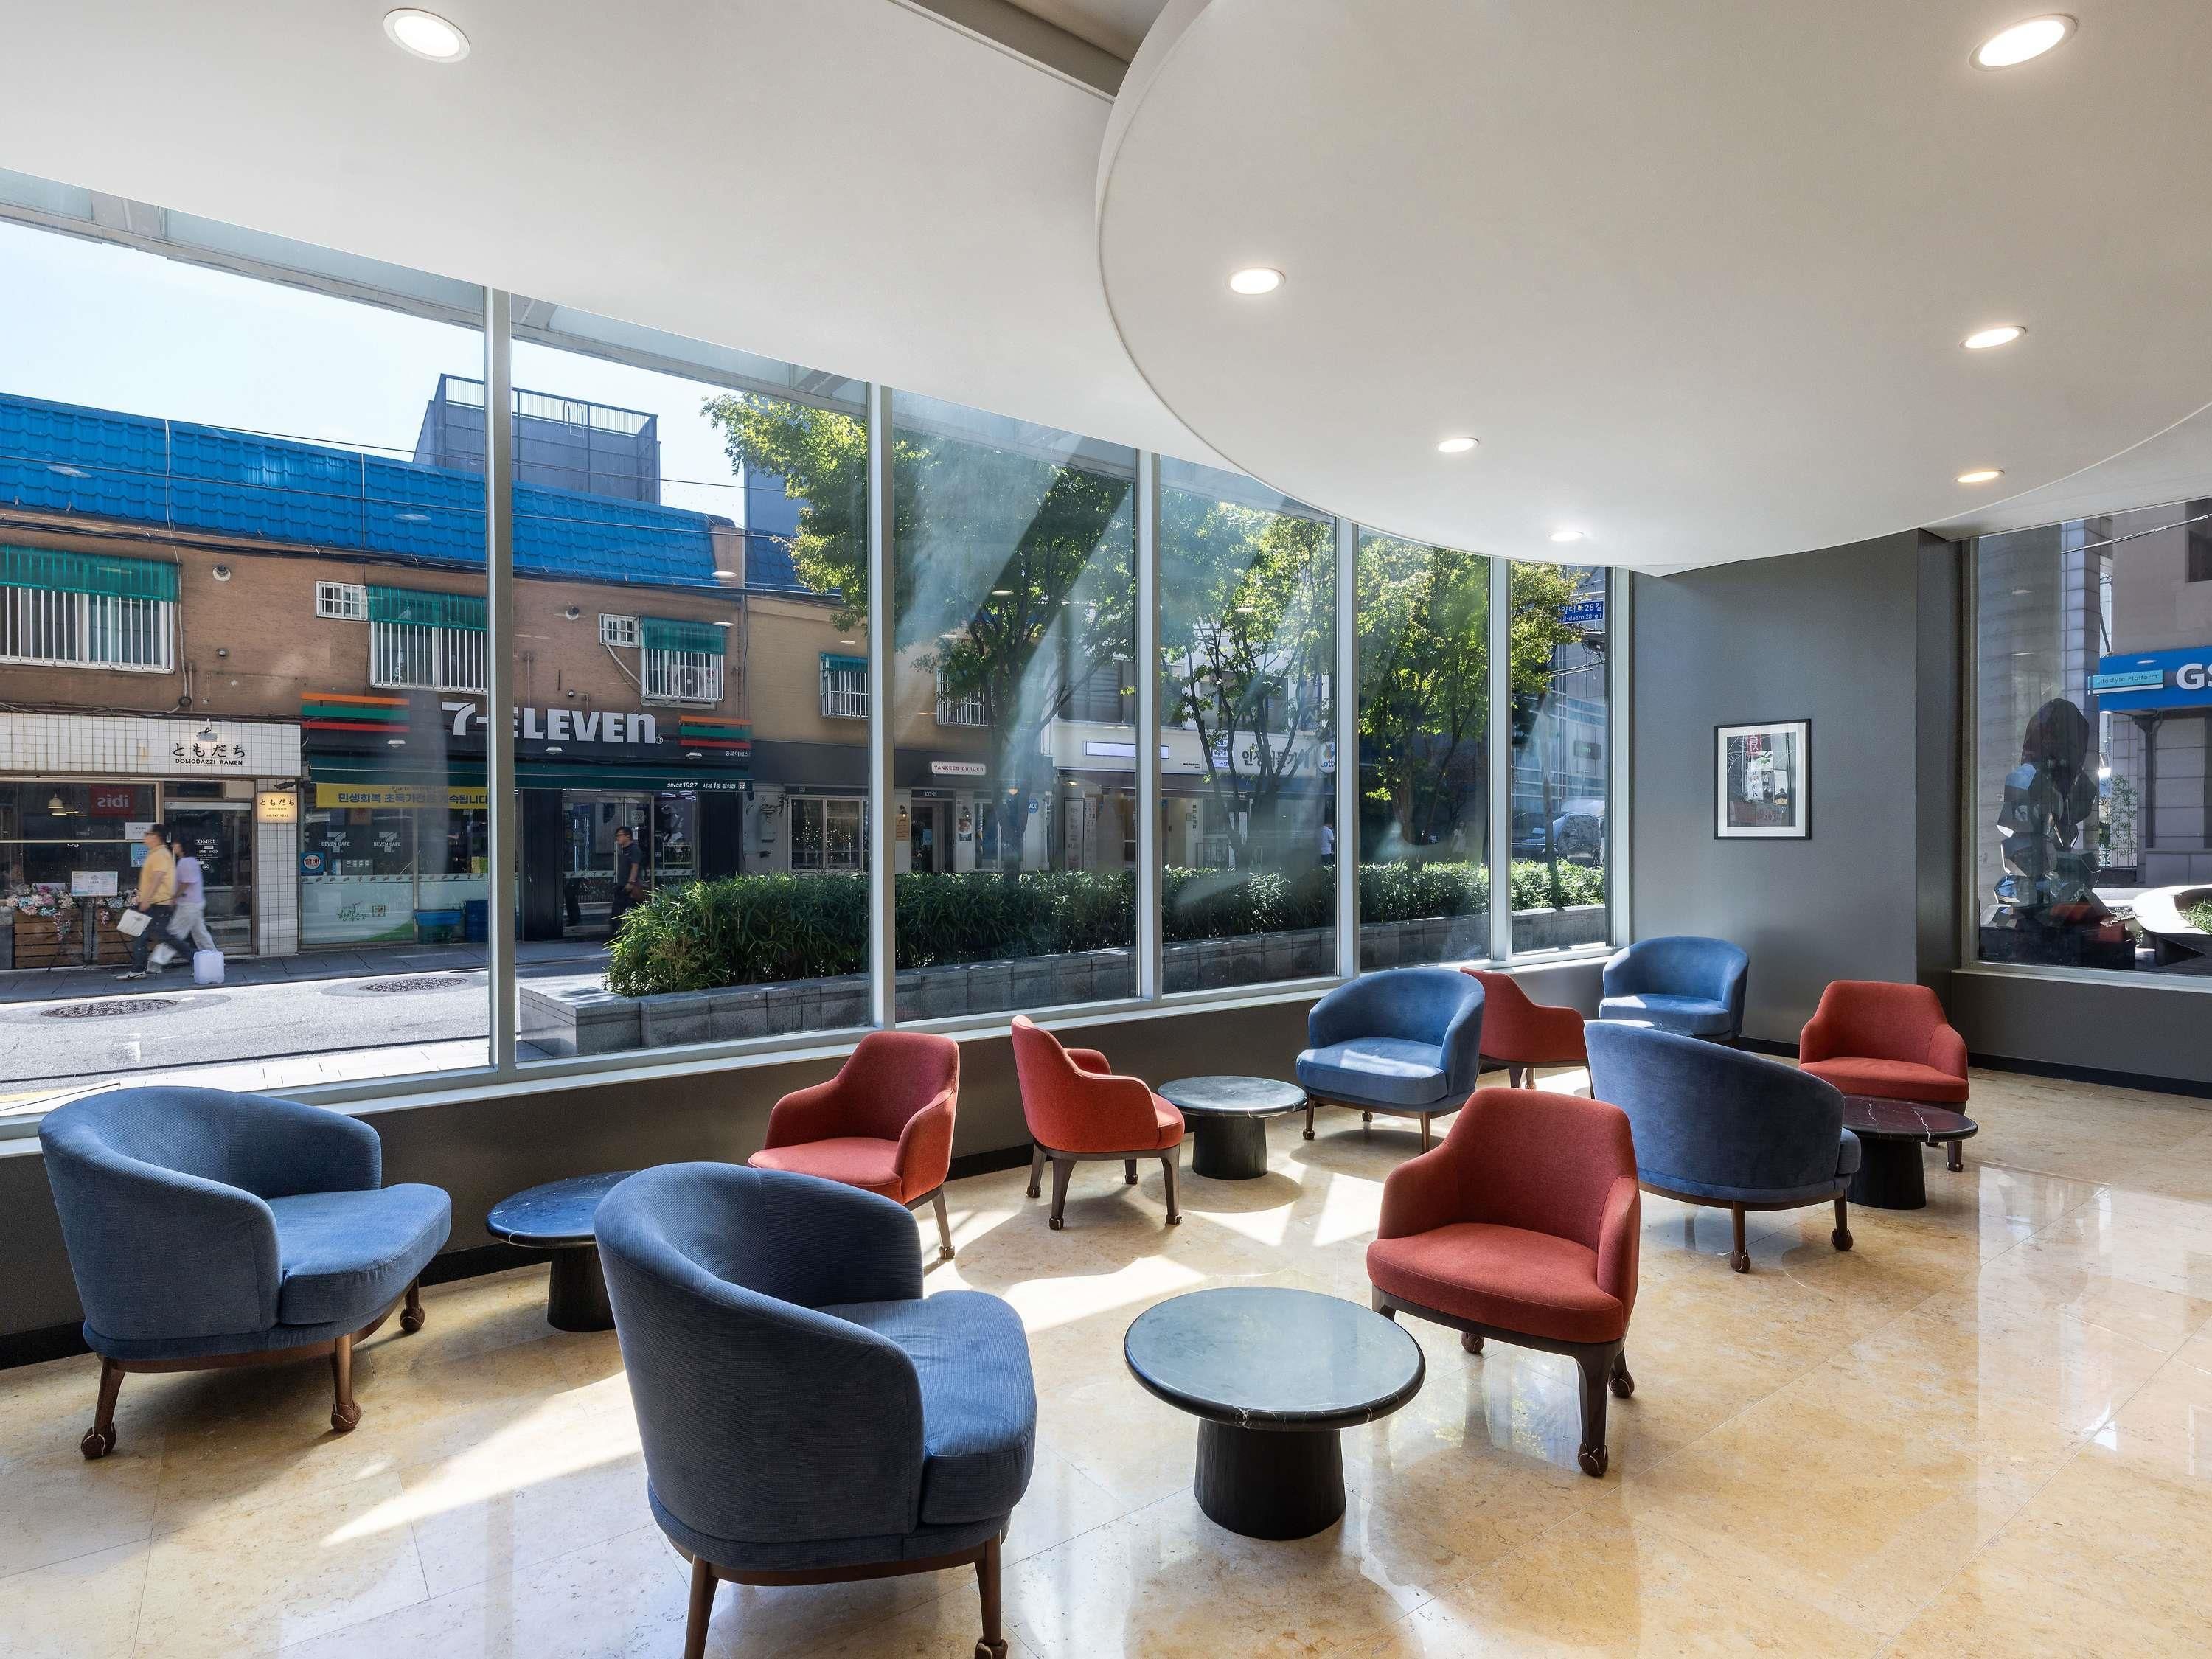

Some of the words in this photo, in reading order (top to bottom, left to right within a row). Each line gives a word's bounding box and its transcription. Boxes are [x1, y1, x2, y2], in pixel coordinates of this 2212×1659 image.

[2176, 663, 2212, 690] G
[442, 701, 655, 744] 7-LEVEn
[173, 742, 245, 758] ともだち
[1320, 759, 1335, 768] Lott
[338, 793, 381, 803] 민생회복
[439, 793, 488, 804] 속됩니다
